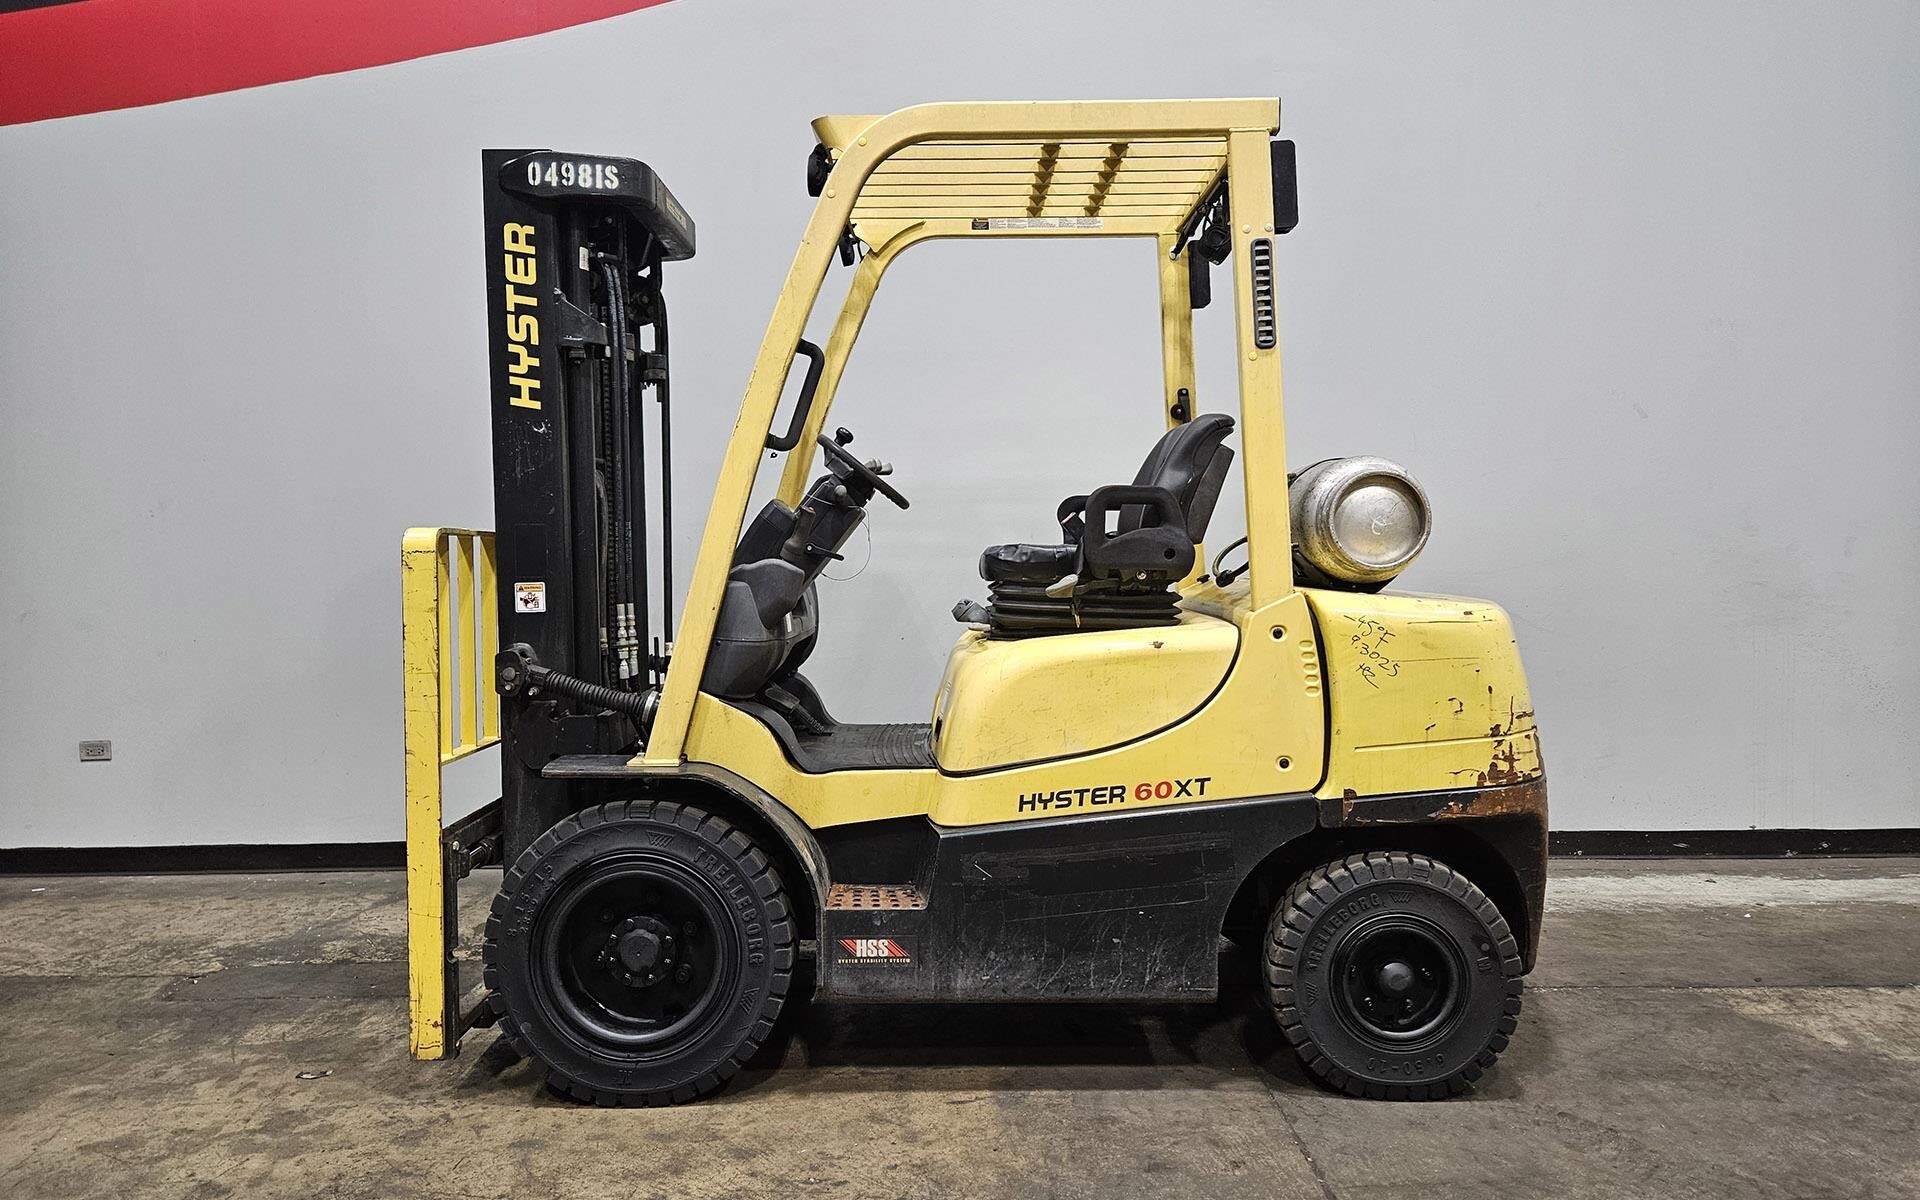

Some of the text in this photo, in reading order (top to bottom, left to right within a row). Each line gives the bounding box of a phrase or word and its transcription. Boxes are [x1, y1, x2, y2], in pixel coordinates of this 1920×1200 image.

[503, 222, 541, 410] HYSTER
[1018, 785, 1127, 812] HYSTER
[691, 846, 765, 968] TRELLEBORG
[856, 939, 889, 957] HSS
[1306, 892, 1386, 974] TRELLEBORG
